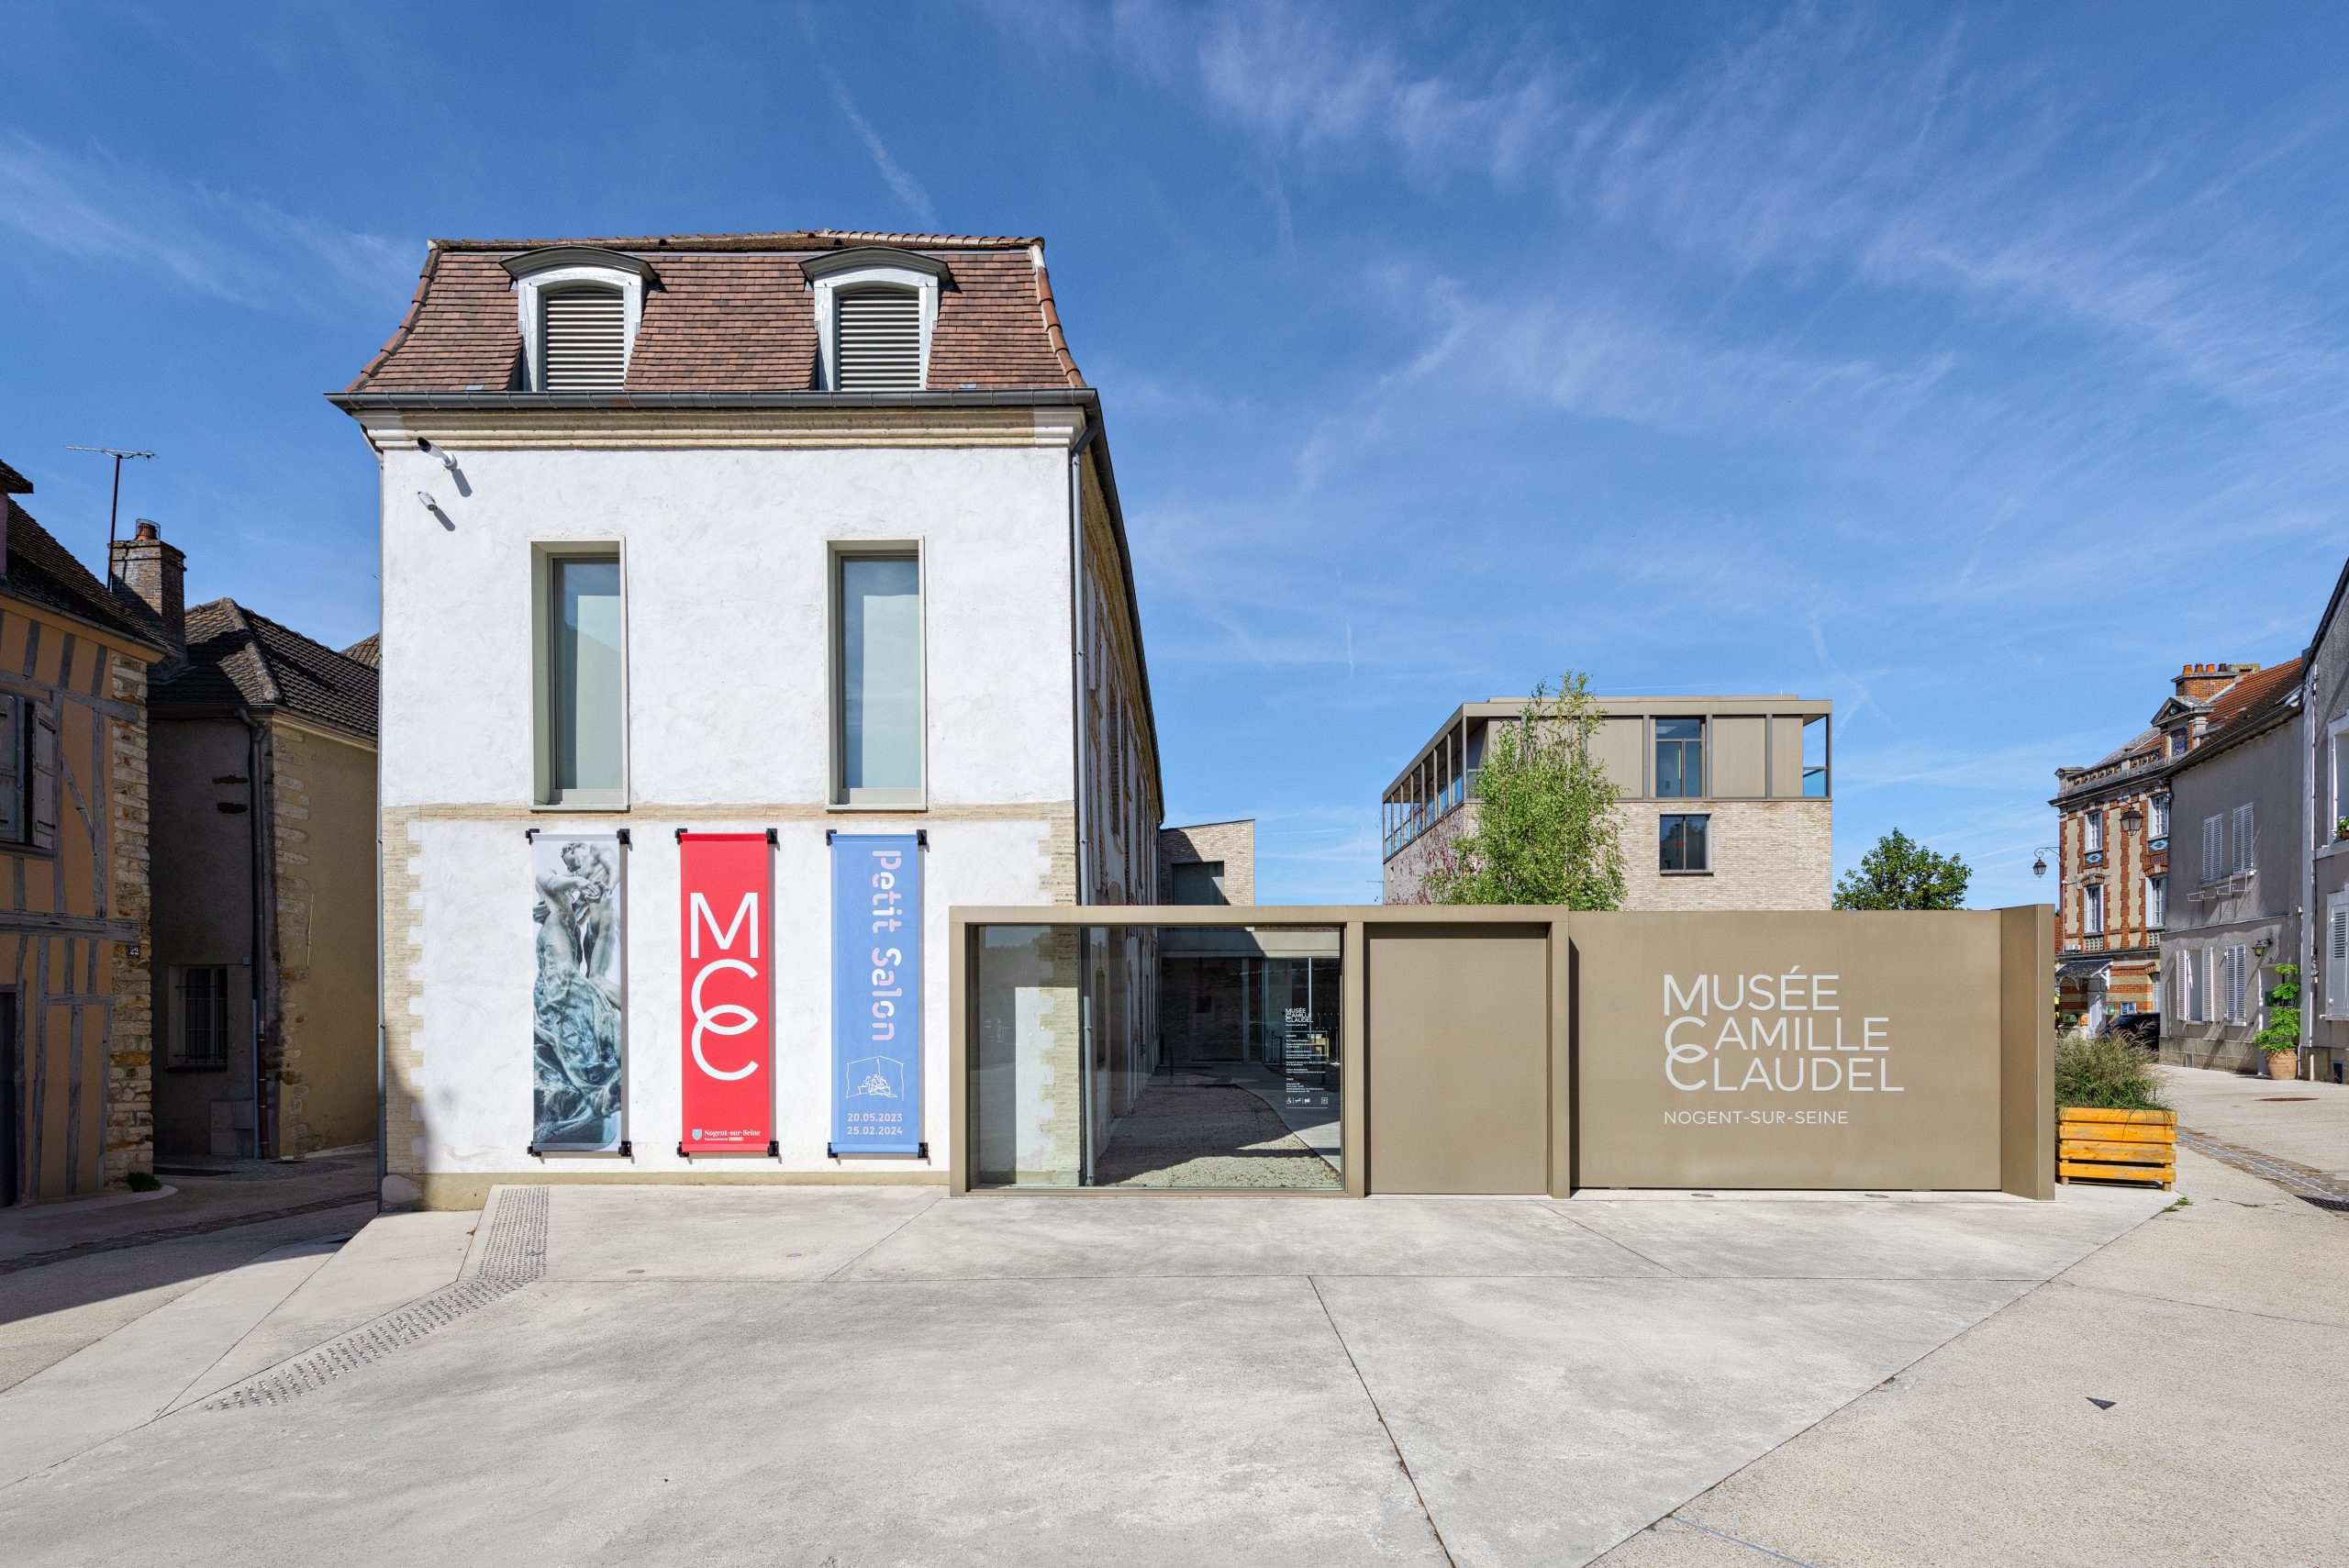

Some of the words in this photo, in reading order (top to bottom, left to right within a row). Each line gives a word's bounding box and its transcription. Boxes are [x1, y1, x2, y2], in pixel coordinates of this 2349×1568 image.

[873, 851, 902, 933] Petit
[872, 947, 902, 1040] Salon
[1664, 965, 1840, 1016] MUSÉE
[1664, 1016, 1889, 1063] CAMILLE
[1664, 1043, 1905, 1092] CLAUDEL
[704, 1129, 761, 1138] Nogent-sur-Seine
[847, 1113, 903, 1122] 20.05.2023
[847, 1126, 903, 1135] 25.02.2024
[1664, 1110, 1849, 1125] NOGENT-SUR-SEINE
